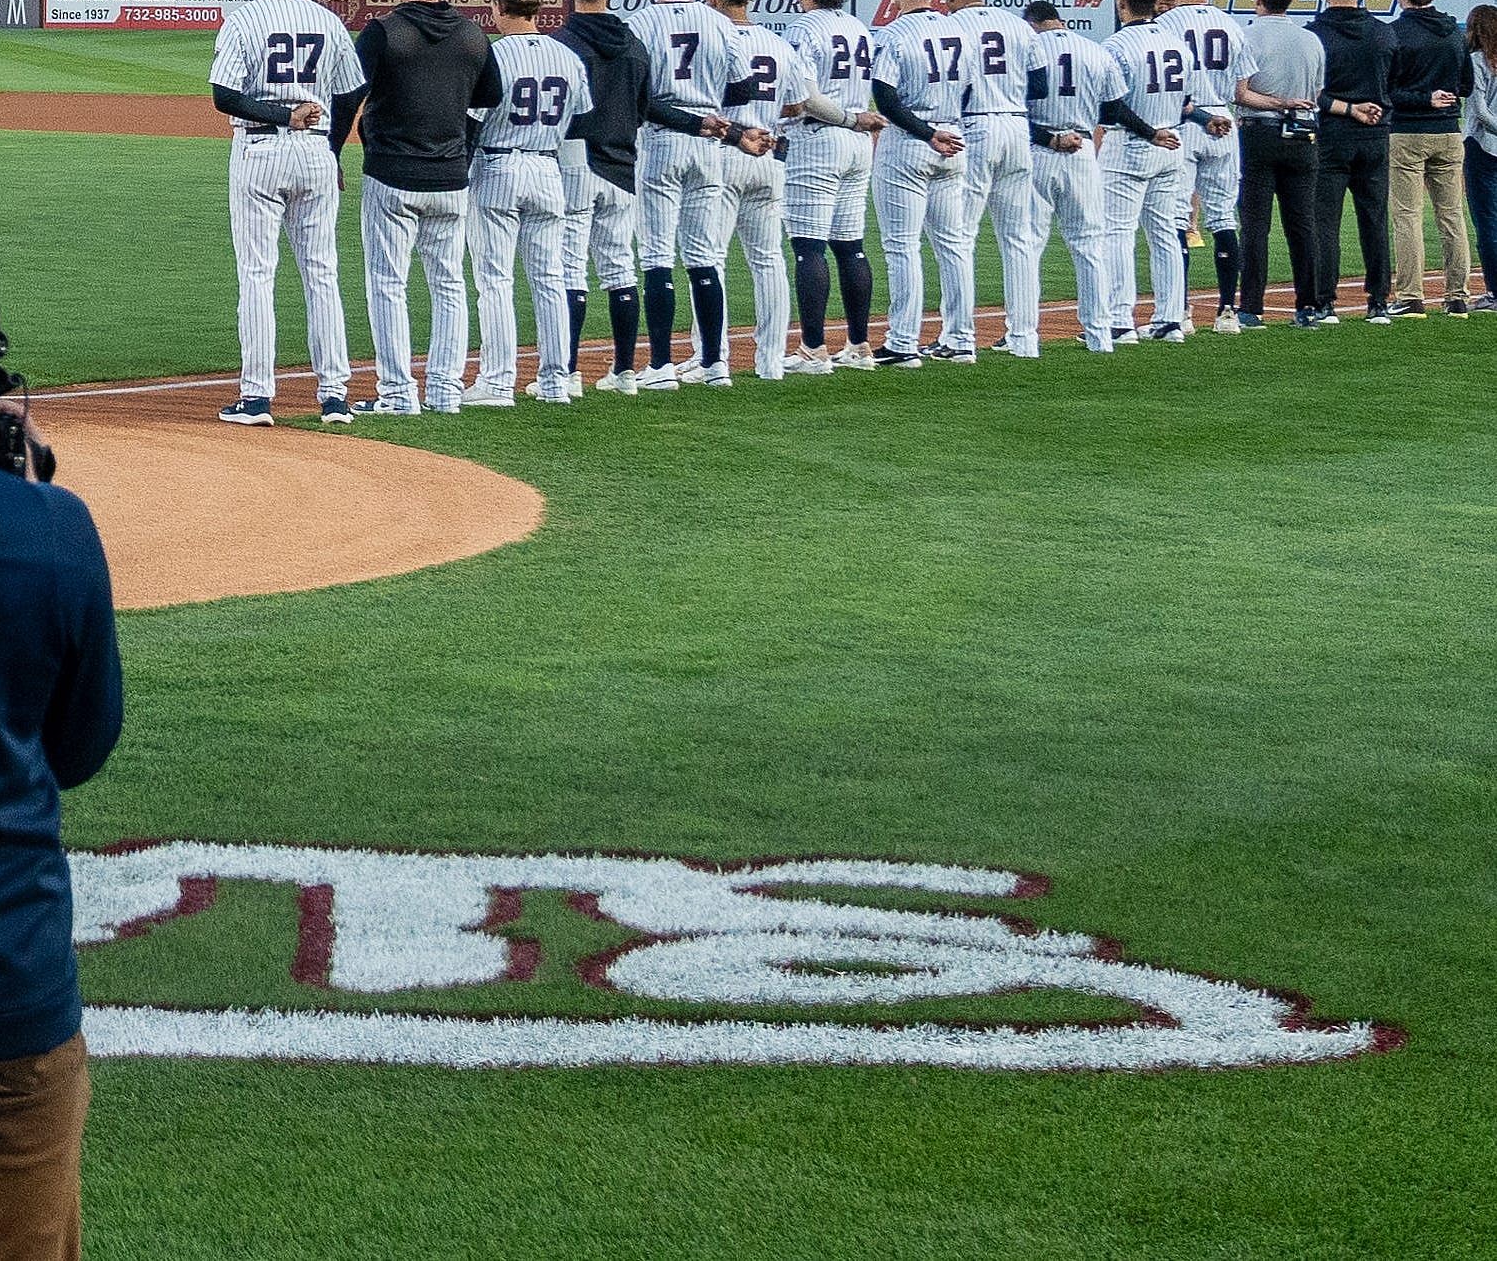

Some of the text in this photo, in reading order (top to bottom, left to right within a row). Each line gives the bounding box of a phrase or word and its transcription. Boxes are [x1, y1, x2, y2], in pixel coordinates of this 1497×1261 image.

[51, 9, 109, 20] Since 1937
[124, 8, 217, 22] 732-985-3000
[267, 33, 325, 84] 27
[670, 33, 700, 80] 7
[830, 35, 871, 80] 24
[923, 37, 962, 84] 17
[983, 32, 1007, 75] 2
[1147, 50, 1183, 94] 12
[509, 76, 568, 126] 93
